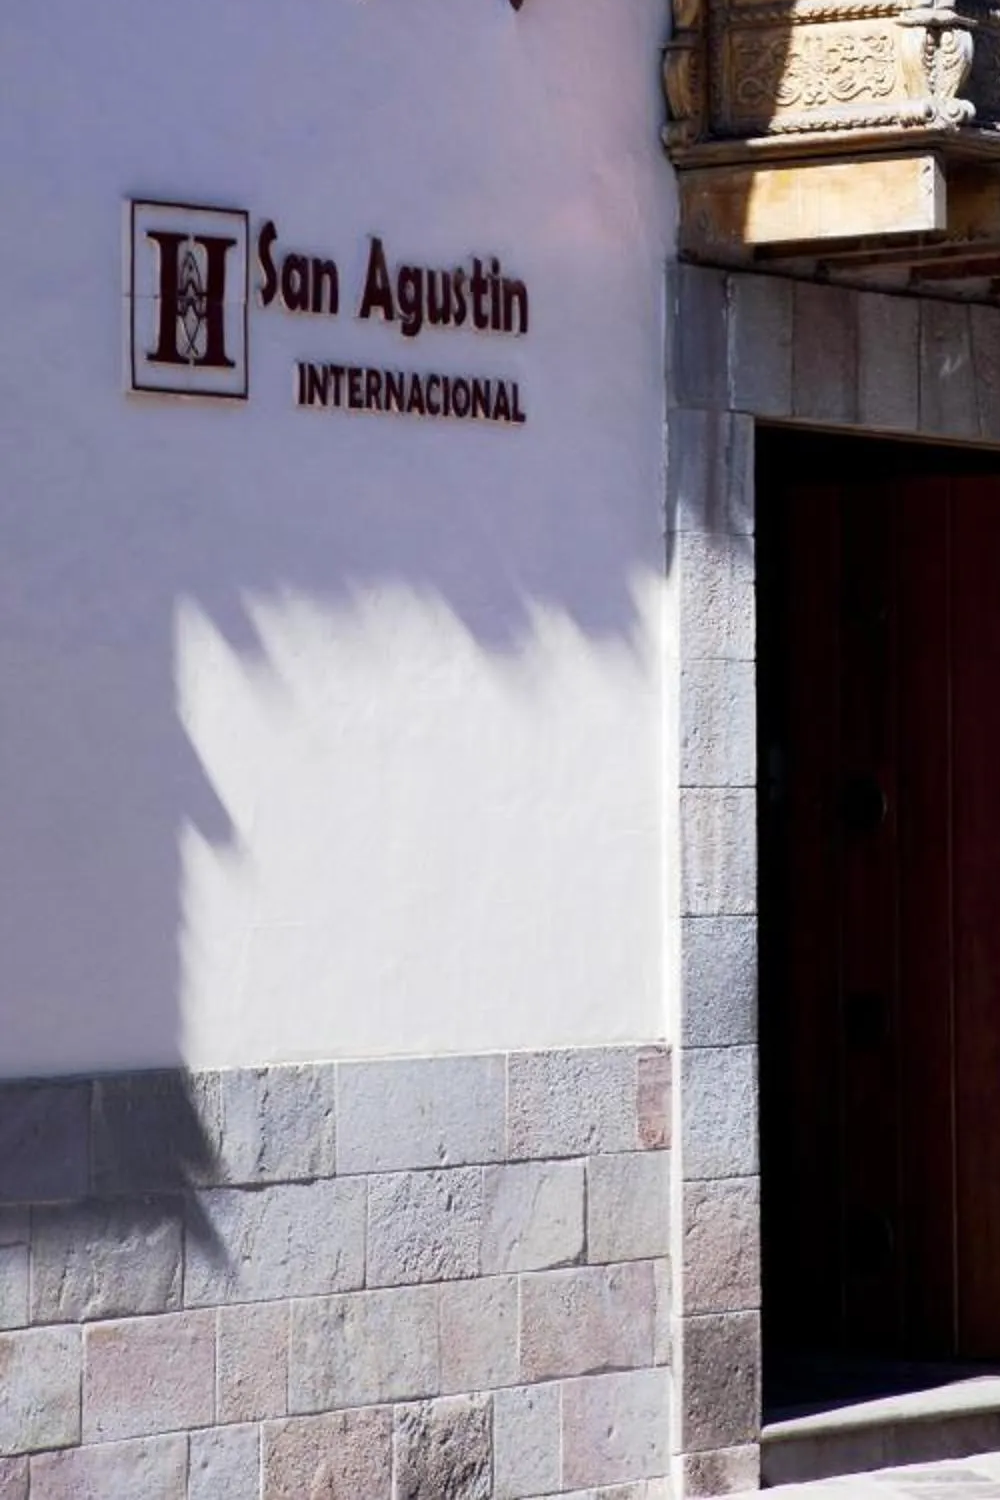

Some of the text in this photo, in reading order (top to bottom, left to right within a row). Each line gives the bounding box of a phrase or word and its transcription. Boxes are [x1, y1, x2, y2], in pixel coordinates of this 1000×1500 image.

[257, 220, 529, 337] San Agustin
[297, 361, 526, 423] INTERNACIONAL
